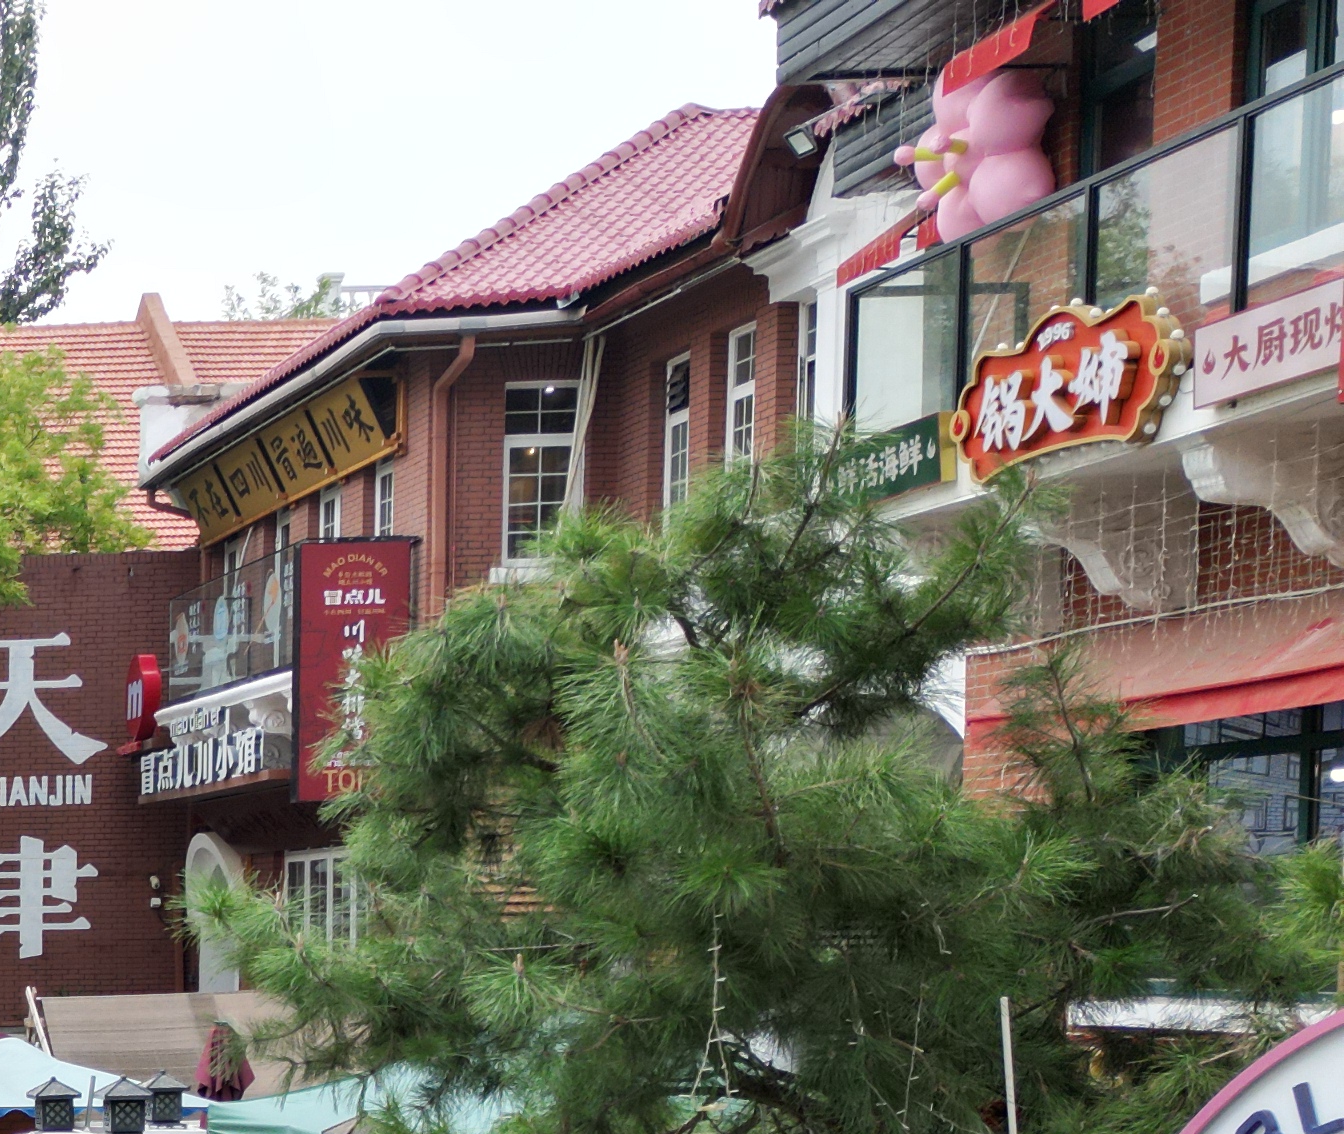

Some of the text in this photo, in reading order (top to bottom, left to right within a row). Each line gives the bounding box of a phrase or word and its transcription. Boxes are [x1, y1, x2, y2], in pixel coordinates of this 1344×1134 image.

[1037, 322, 1075, 352] 1996
[322, 556, 346, 579] MAO
[347, 553, 375, 566] DIAN
[374, 561, 389, 578] ER
[140, 728, 257, 795] 冒点儿川小馆
